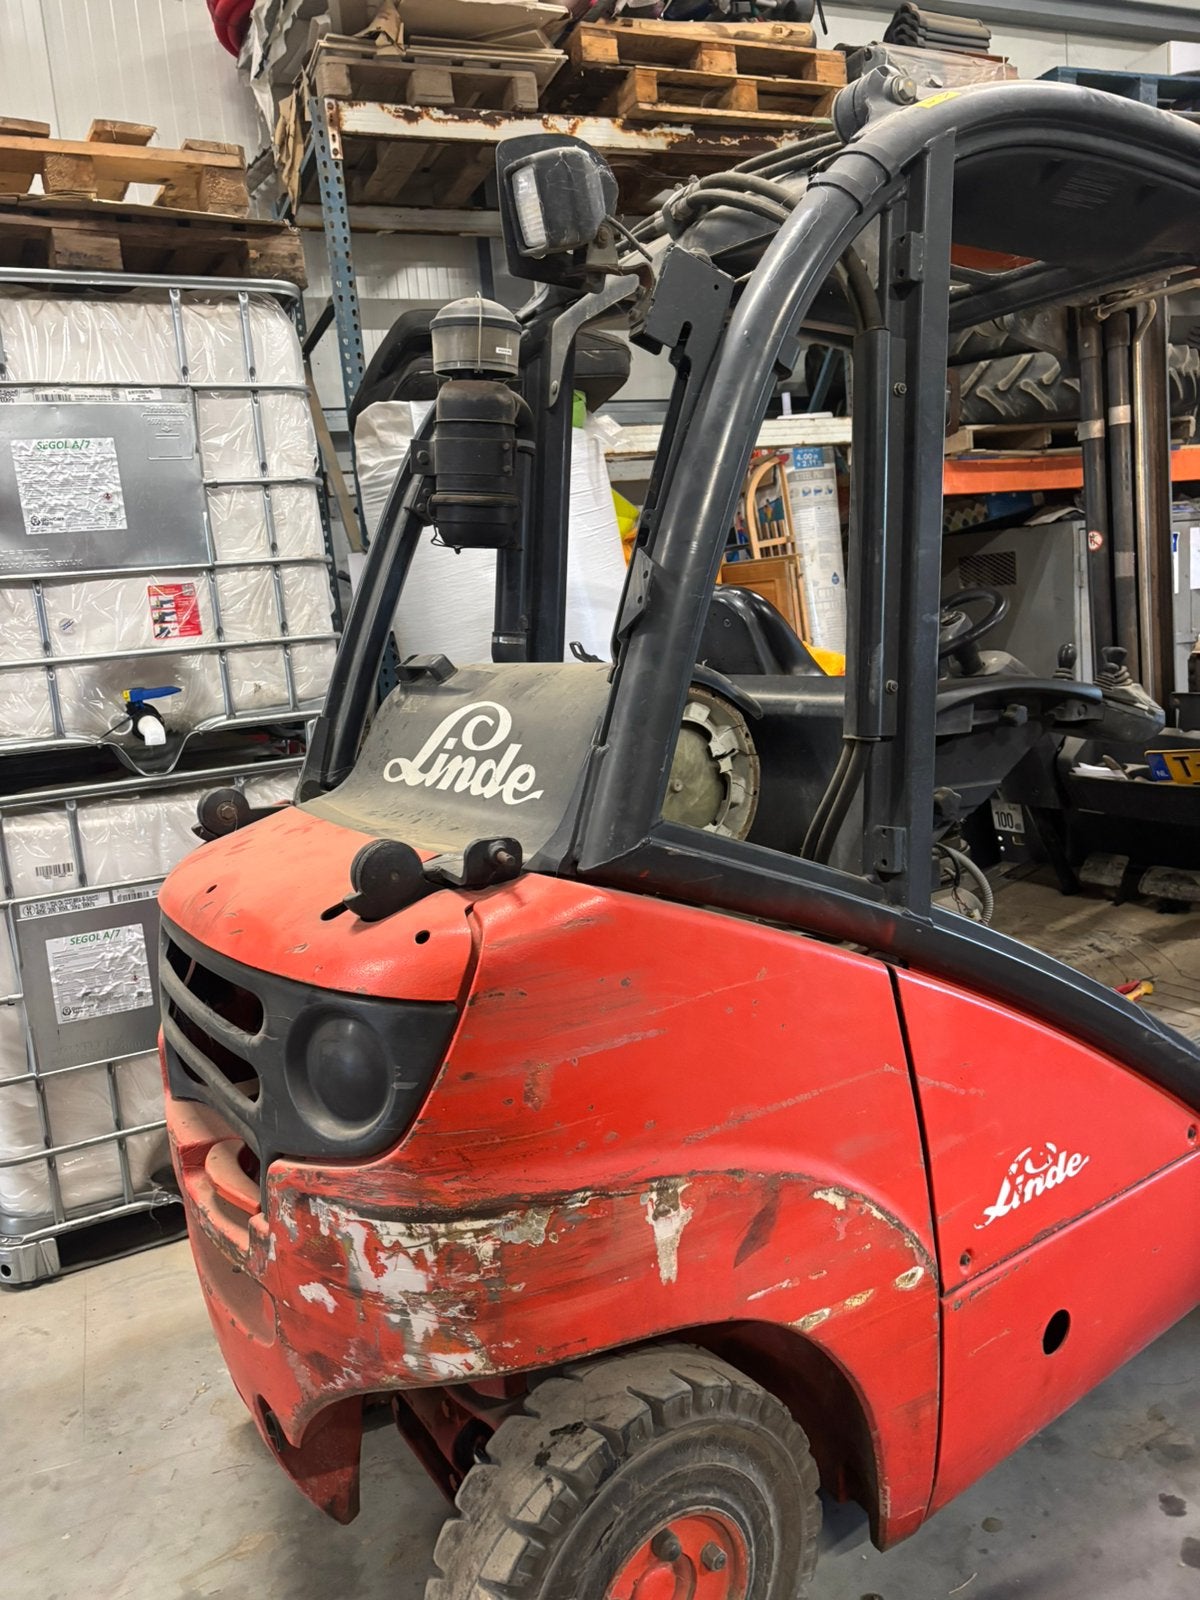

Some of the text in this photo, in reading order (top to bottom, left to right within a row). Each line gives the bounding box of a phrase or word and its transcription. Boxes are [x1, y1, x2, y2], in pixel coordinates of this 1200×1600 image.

[36, 439, 90, 450] SEGOL A/7
[383, 701, 544, 805] Linde
[995, 811, 1014, 829] 100
[69, 930, 121, 945] SEGOL A/7
[974, 1142, 1090, 1229] Linde
